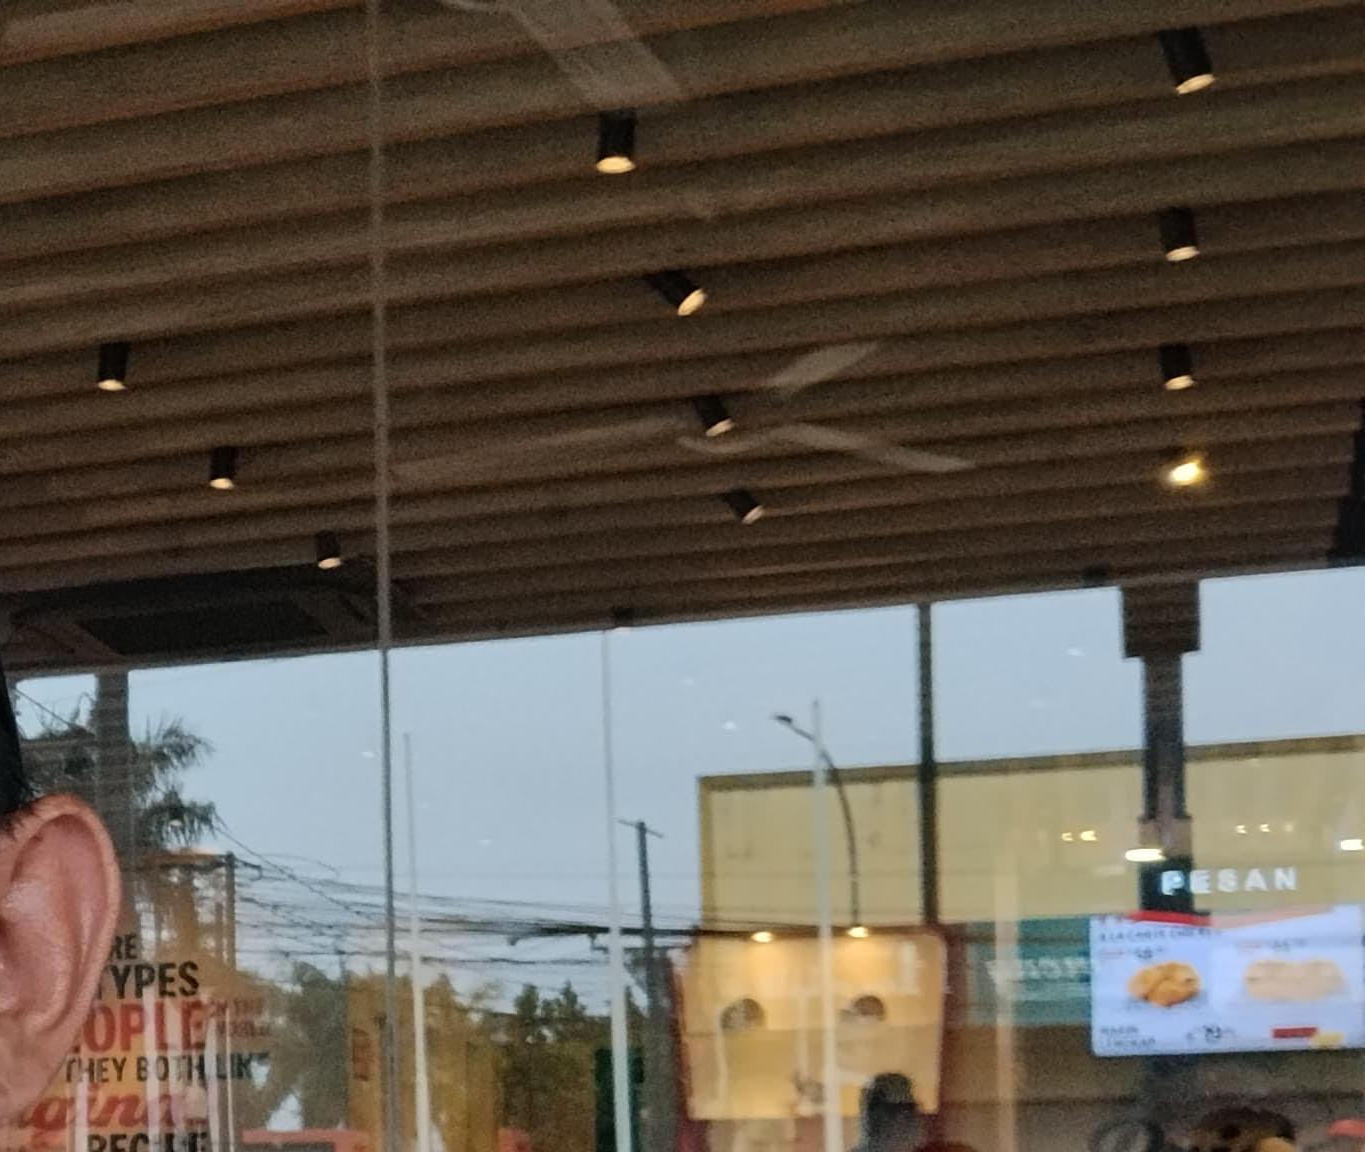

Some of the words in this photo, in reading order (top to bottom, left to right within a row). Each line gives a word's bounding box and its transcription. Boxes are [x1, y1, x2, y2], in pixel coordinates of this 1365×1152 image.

[1160, 867, 1298, 896] PESAN
[72, 1000, 207, 1053] OPLE
[65, 1056, 127, 1084] THEY
[136, 1054, 207, 1085] BOTH
